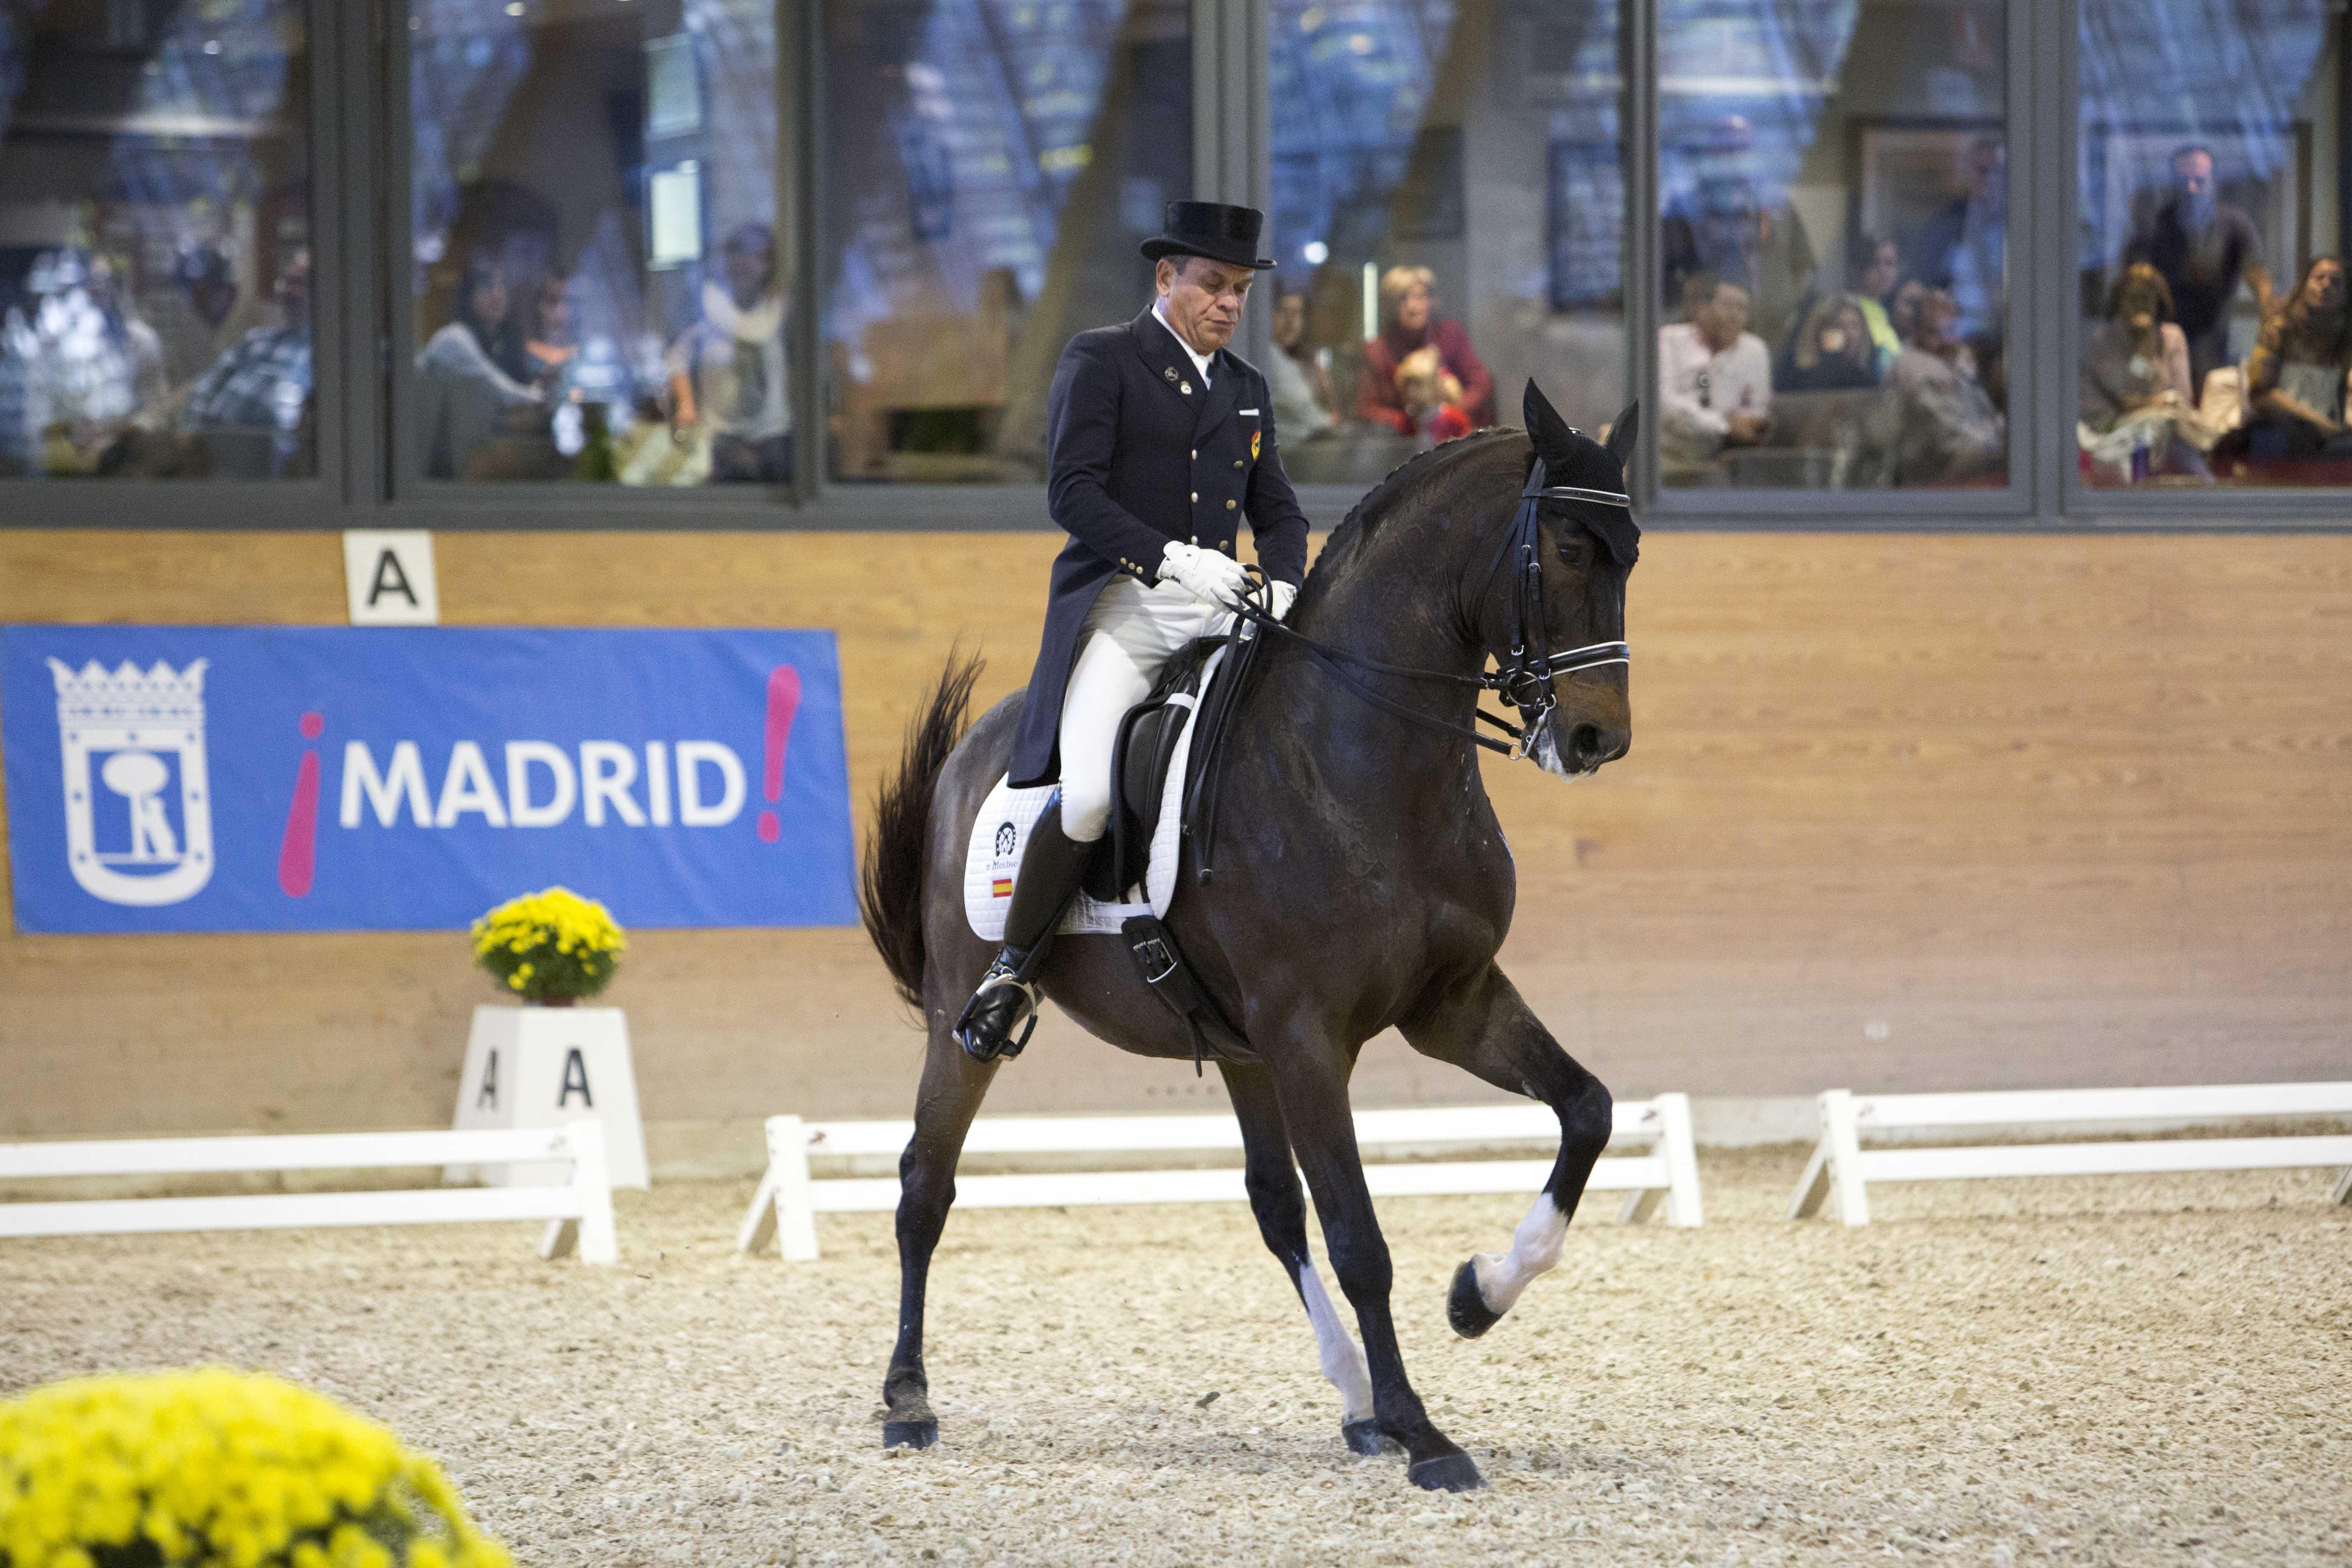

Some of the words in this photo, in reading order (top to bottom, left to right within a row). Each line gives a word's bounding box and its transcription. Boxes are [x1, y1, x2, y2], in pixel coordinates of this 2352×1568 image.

[366, 549, 418, 606] A
[477, 1047, 499, 1108] A
[556, 1047, 593, 1108] A
